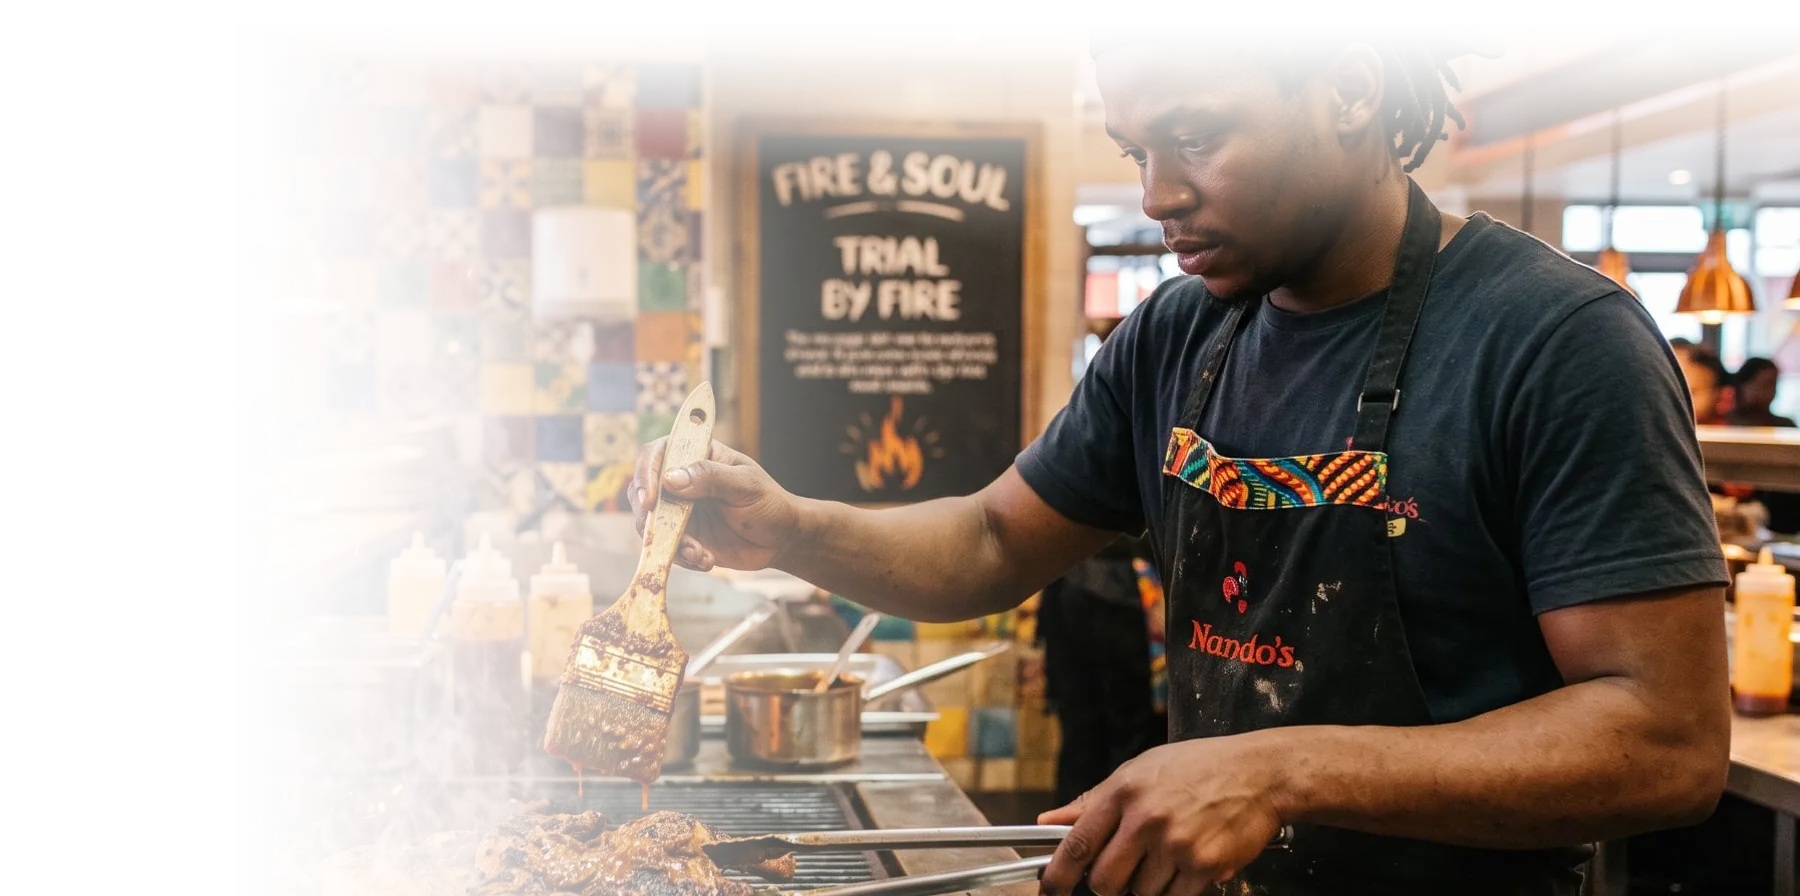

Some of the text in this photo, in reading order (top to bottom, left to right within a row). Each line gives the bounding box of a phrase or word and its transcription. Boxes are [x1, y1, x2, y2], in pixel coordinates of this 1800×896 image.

[772, 150, 1010, 211] FIRE & SOUL
[833, 235, 949, 276] TRIAL
[821, 279, 961, 321] BY FIRE
[1188, 619, 1295, 668] Nando's
